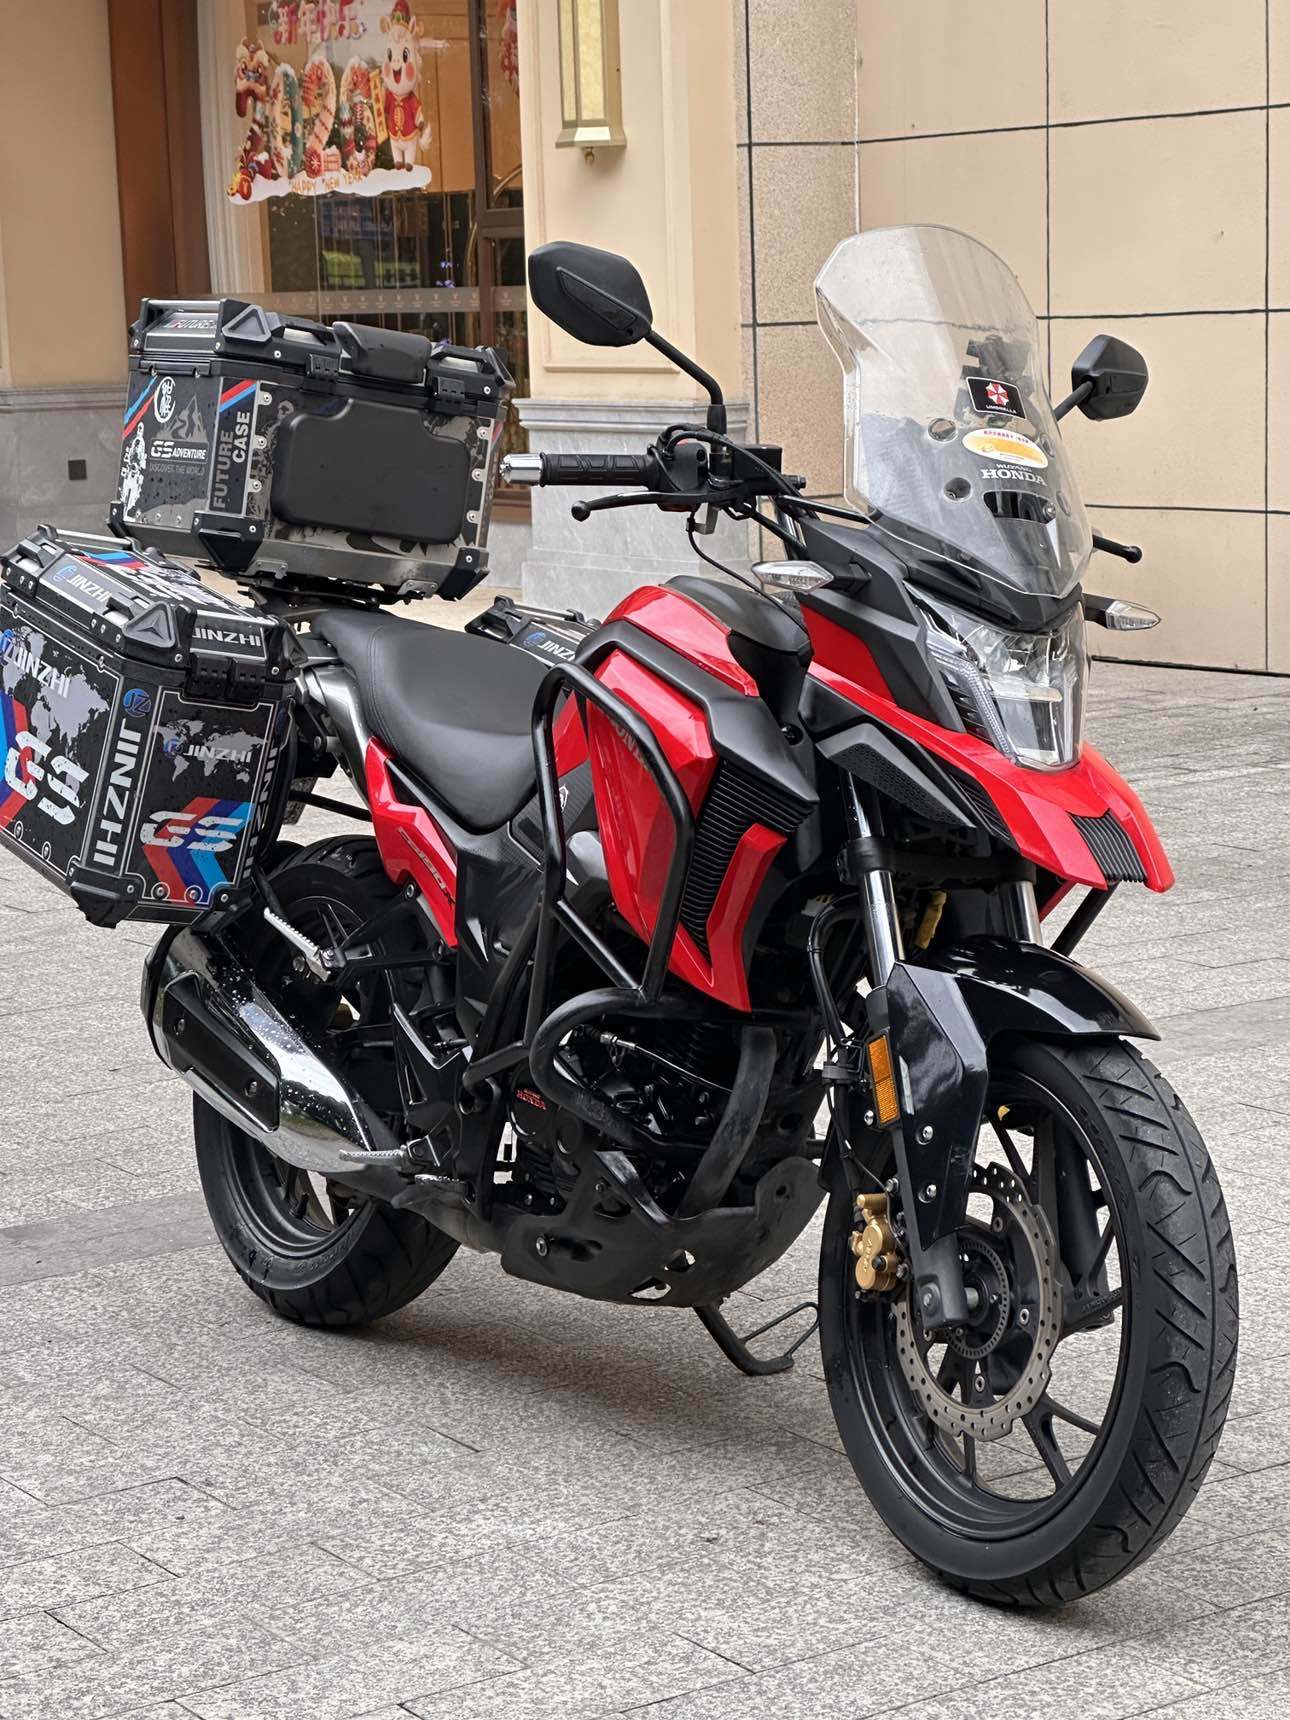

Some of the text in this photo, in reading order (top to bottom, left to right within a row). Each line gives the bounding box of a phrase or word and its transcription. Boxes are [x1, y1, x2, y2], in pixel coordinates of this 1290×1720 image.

[172, 447, 207, 460] ADVENTURE
[232, 411, 250, 463] CASE
[213, 430, 234, 508] FUTURE
[980, 469, 1048, 486] HONDA
[192, 626, 261, 647] JINZHI
[13, 646, 71, 699] JINZHI
[183, 745, 251, 763] JINZHI
[4, 731, 89, 825] GS
[93, 718, 142, 866] JINZHI
[140, 811, 244, 852] GS
